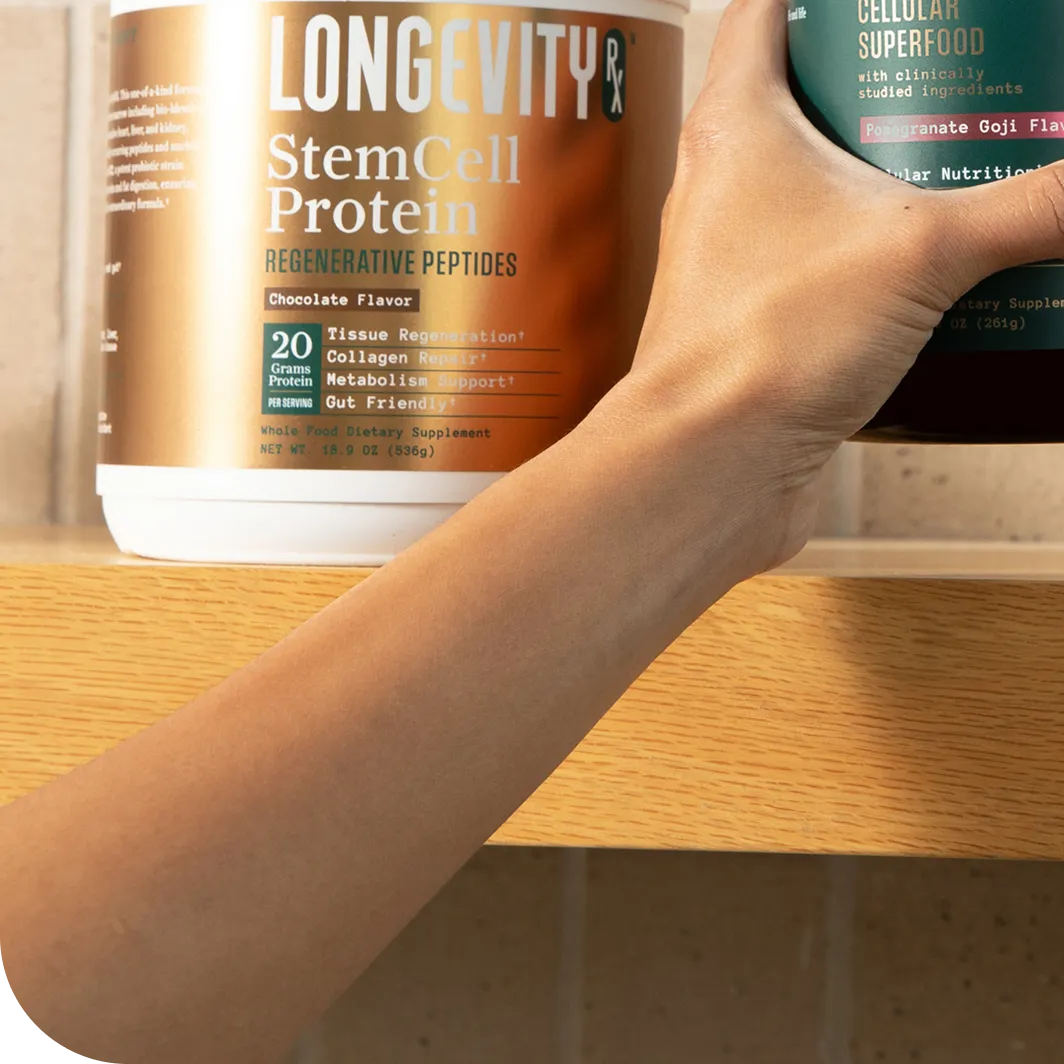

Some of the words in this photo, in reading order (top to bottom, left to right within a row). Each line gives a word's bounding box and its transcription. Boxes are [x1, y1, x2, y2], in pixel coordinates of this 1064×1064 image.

[858, 27, 985, 59] SUPERFOOD
[269, 14, 597, 119] LONGEVITY
[858, 69, 888, 83] with
[895, 67, 984, 82] clinically
[858, 85, 912, 99] studied
[921, 83, 1023, 98] ingredients
[979, 119, 1017, 135] Goji
[267, 132, 521, 184] StemCell
[266, 186, 479, 235] Protein
[265, 249, 416, 276] REGENERATIVE
[422, 251, 517, 277] PEPTIDES
[269, 292, 348, 307] Chocolate
[357, 293, 413, 307] Flavor
[977, 317, 1026, 331] (261g)
[328, 327, 388, 341] Tissue
[271, 331, 313, 359] 20
[327, 350, 408, 366] Collagen
[271, 363, 311, 374] Grams
[269, 375, 313, 387] Protein
[327, 372, 428, 387] Metabolism
[268, 397, 282, 408] PER
[283, 397, 313, 408] SERVING
[325, 396, 356, 409] Gut
[260, 425, 297, 436] Whole
[307, 426, 338, 436] Food
[347, 426, 403, 440] Dietary
[412, 427, 491, 440] Supplement
[260, 444, 283, 455] NET
[362, 445, 379, 456] OZ
[388, 444, 435, 458] (536g)
